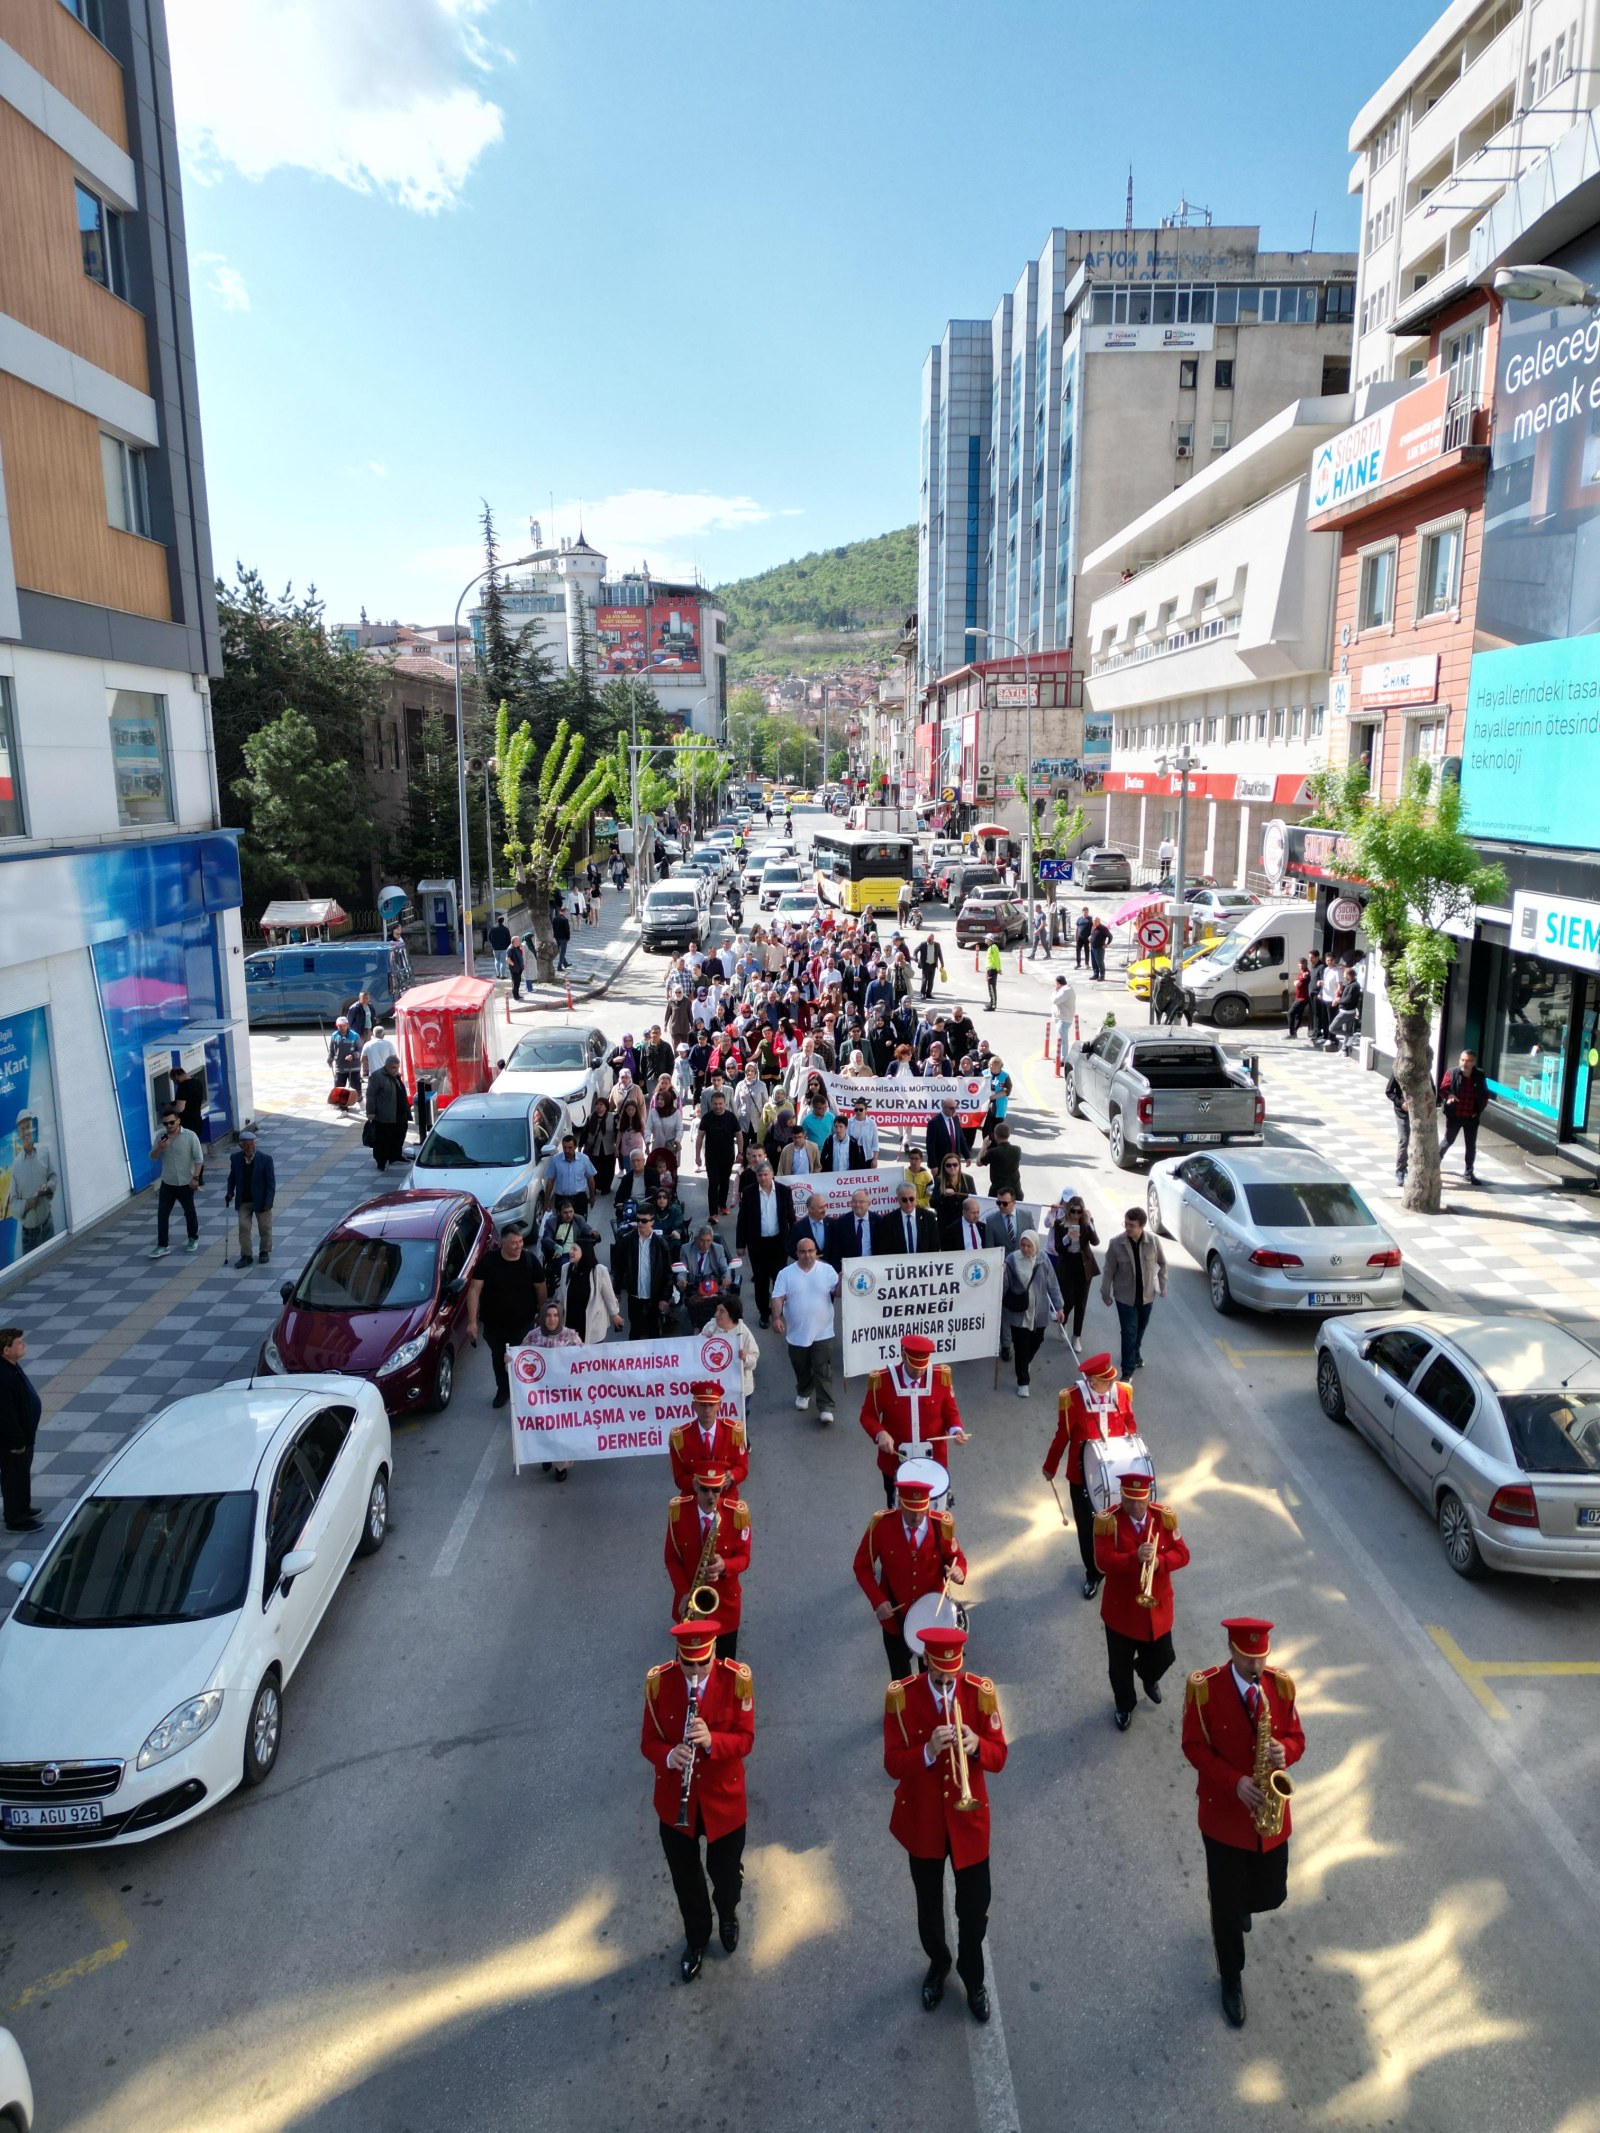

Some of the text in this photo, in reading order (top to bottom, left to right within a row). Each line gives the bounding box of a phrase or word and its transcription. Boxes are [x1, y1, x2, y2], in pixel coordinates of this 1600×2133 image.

[1085, 251, 1138, 268] AFYON
[1513, 376, 1584, 443] merak
[1332, 449, 1381, 500] HANE
[997, 688, 1038, 697] SATILK
[1476, 680, 1566, 712] Hayallerindeki
[1474, 716, 1542, 743] hayallerinin
[1471, 748, 1522, 775] teknoloji
[4, 1055, 29, 1077] Kart
[830, 1082, 900, 1093] AFYONKARAHİSAR
[909, 1083, 957, 1093] MÜFTÜLÜĞÜ
[836, 1175, 880, 1186] ÖZERLER
[871, 1196, 898, 1206] ĞİTİM
[885, 1261, 954, 1281] TÜRKİYE
[877, 1281, 960, 1301] SAKATLAR
[1316, 1294, 1326, 1303] 03
[1346, 1293, 1361, 1303] 999
[882, 1298, 954, 1318] DERNEĞİ
[851, 1313, 985, 1344] AFYONKARAHİSAR ŞUBESİ
[570, 1352, 680, 1375] AFYONKARAHİSAR
[528, 1384, 582, 1407] OTİSTİK
[587, 1383, 665, 1404] ÇOCUKLAR
[517, 1401, 739, 1431] YARDIMLAŞMA ve DAYAMA
[597, 1425, 663, 1451] DERNEĞİ
[13, 1806, 99, 1824] 03 AGU 926
